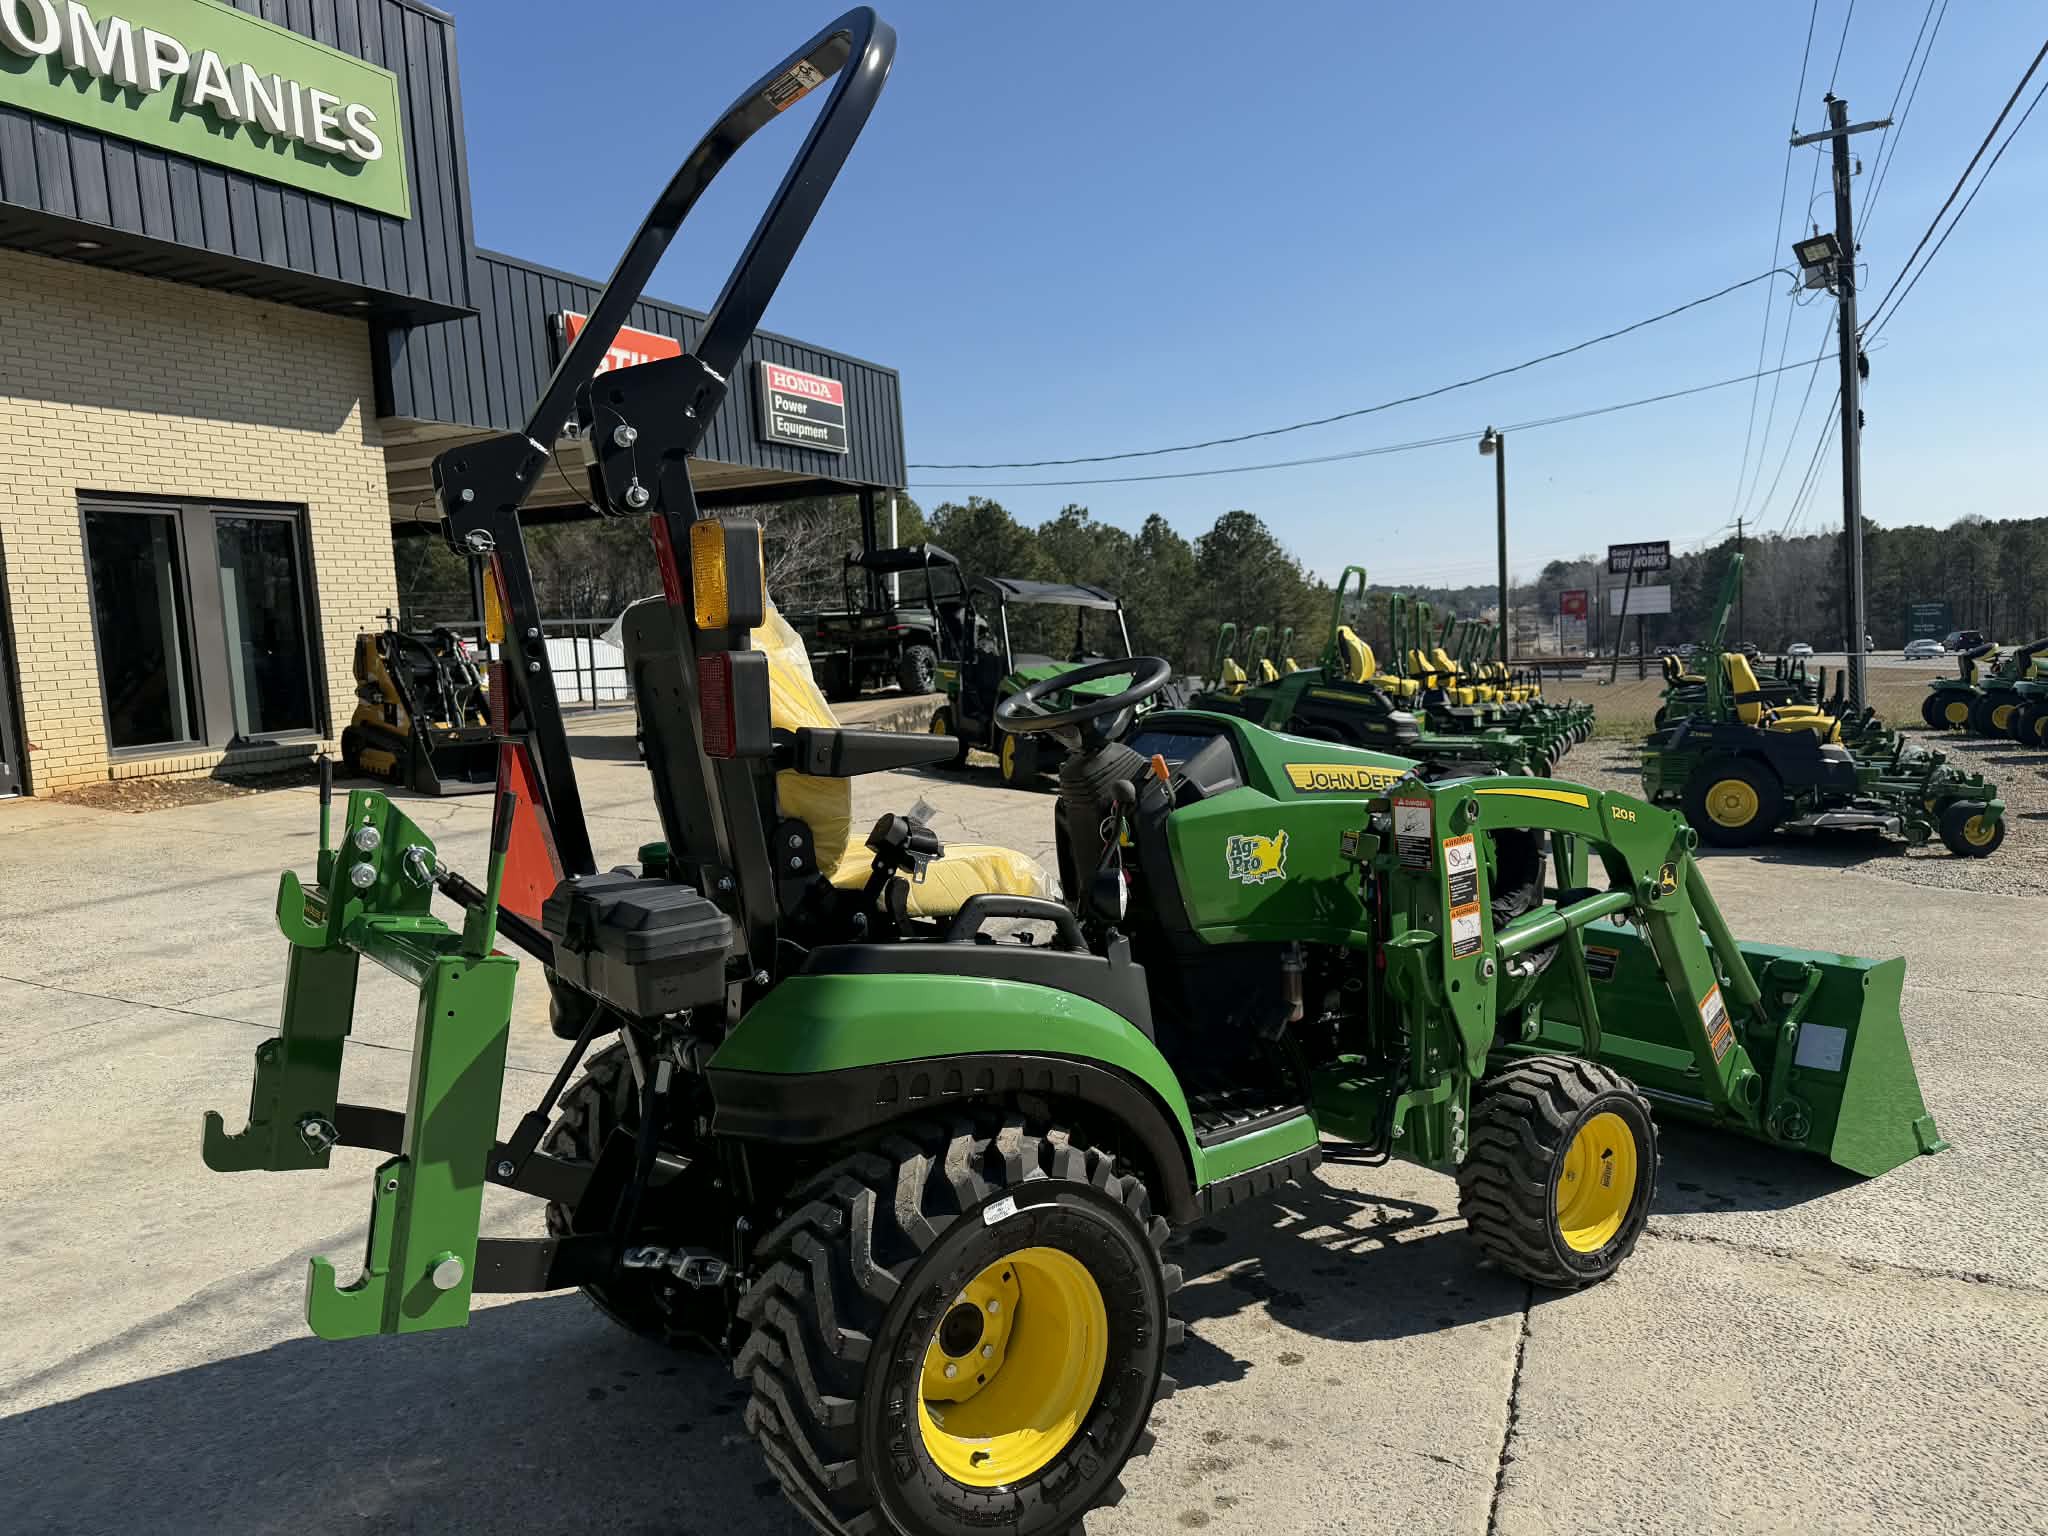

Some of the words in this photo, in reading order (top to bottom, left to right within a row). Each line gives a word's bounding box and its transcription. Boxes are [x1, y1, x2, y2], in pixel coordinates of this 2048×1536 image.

[0, 0, 384, 162] OMPANIES
[773, 371, 832, 398] HONDA
[775, 395, 807, 415] Power
[777, 416, 829, 440] Equipment
[1612, 554, 1666, 569] FIRWORKS
[1306, 770, 1354, 788] JOHN
[1611, 805, 1637, 823] 120R
[1231, 837, 1259, 858] Ag-
[1231, 857, 1261, 875] Pro
